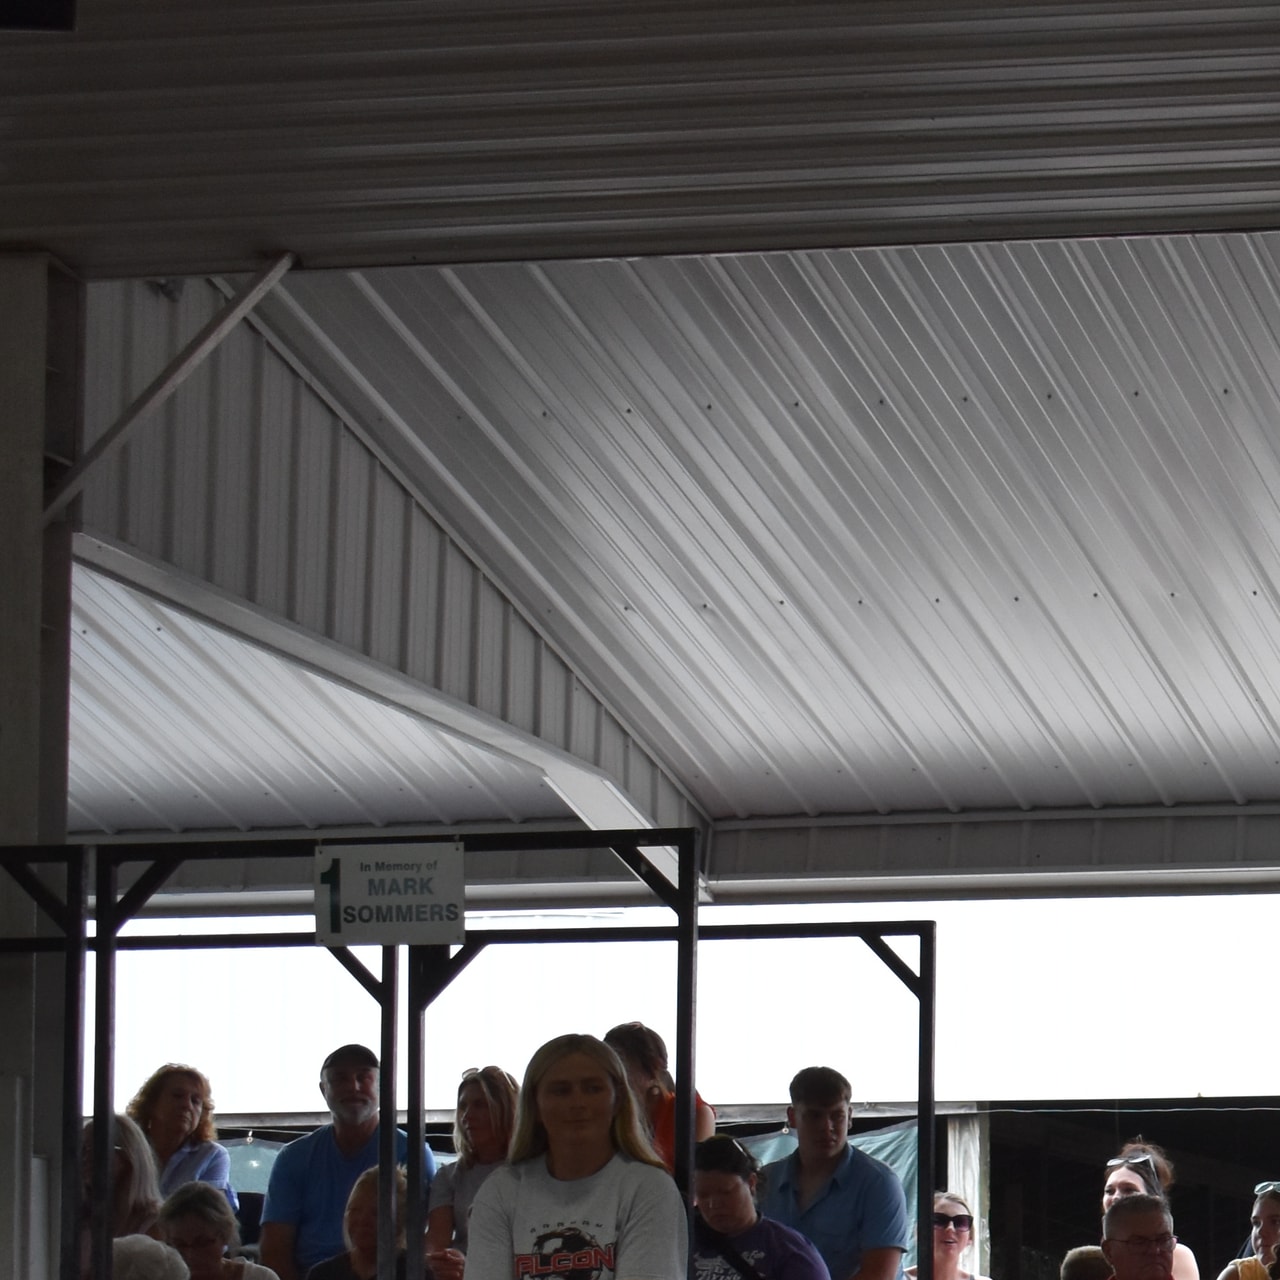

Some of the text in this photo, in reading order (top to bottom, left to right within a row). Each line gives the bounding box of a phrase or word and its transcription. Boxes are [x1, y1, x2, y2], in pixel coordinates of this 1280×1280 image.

[360, 860, 438, 873] In Memory of
[320, 858, 340, 933] 1
[368, 877, 434, 896] MARK
[343, 903, 459, 924] SOMMERS
